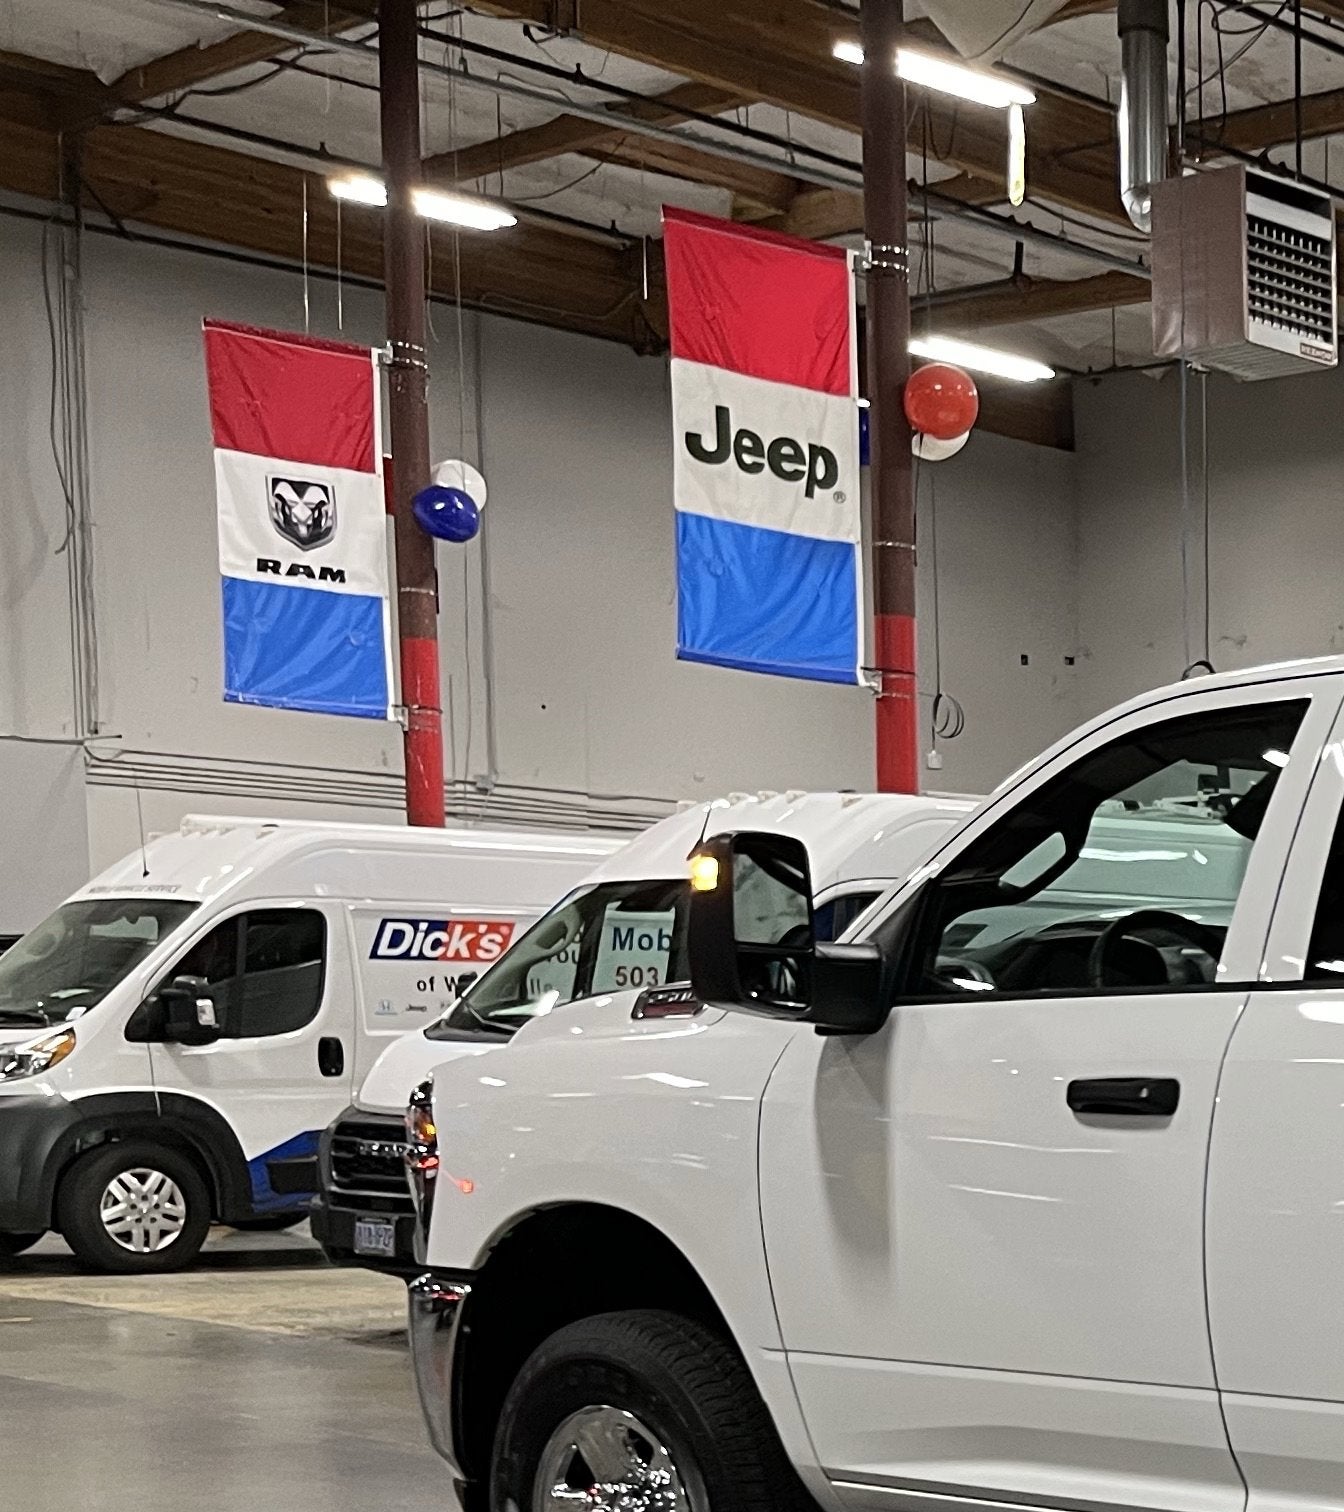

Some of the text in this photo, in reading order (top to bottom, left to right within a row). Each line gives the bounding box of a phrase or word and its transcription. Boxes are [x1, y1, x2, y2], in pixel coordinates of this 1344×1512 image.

[685, 405, 839, 499] Jeep
[256, 558, 346, 583] RAM
[376, 921, 504, 960] Dick's
[416, 975, 435, 992] of
[615, 965, 660, 987] 503
